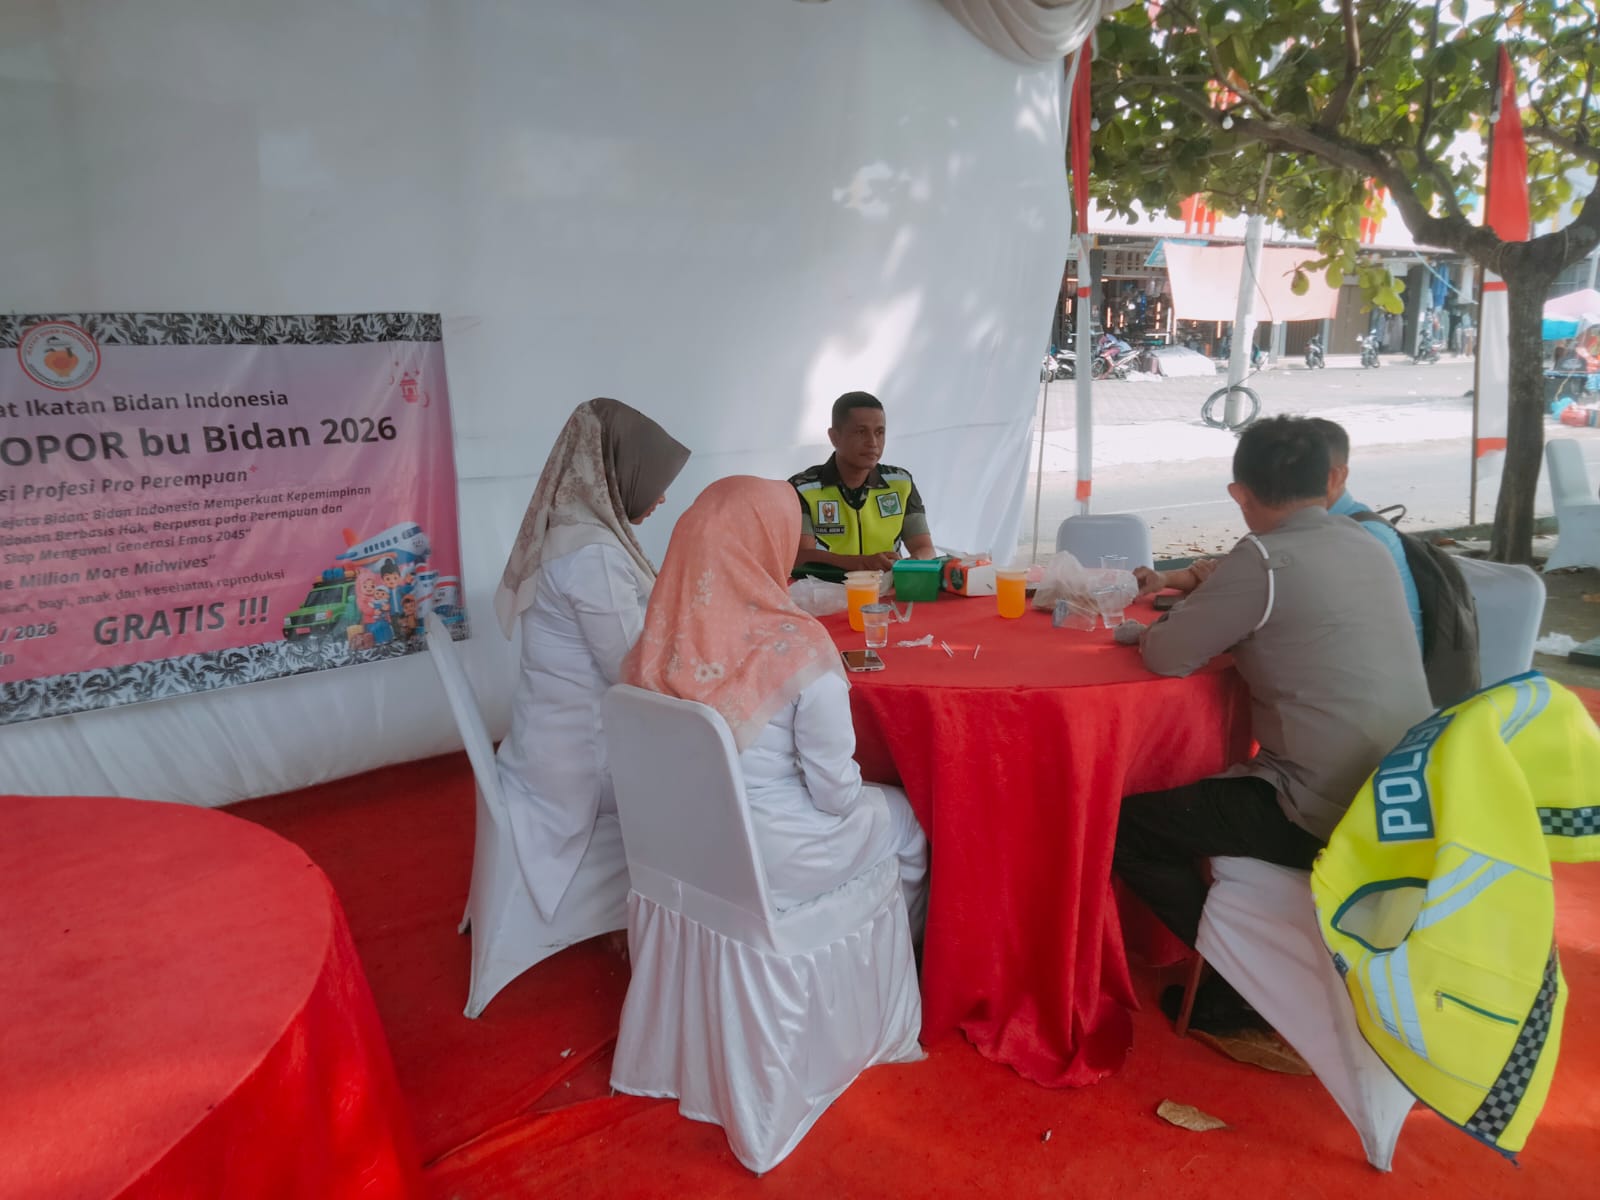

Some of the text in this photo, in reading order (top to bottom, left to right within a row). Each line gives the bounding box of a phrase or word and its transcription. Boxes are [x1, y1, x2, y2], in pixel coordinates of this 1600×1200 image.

[26, 399, 106, 416] Ikatan
[112, 393, 179, 412] Bidan
[185, 390, 289, 408] Indonesia
[0, 416, 397, 467] OPOR bu Bidan 2026
[23, 480, 95, 501] Profesi
[102, 478, 134, 493] Pro
[141, 470, 248, 490] Perempuan
[93, 507, 132, 520] Bidan
[136, 501, 201, 517] Indonesia
[204, 493, 286, 511] Memperkuat
[287, 486, 372, 503] Kepemimpinan
[55, 527, 115, 541] Berbasis
[118, 522, 149, 535] Hak,
[152, 516, 213, 531] Berpusat
[215, 512, 247, 528] pada
[250, 506, 319, 521] Perempuan
[321, 504, 344, 515] dan
[40, 543, 112, 561] Mengawal
[115, 536, 175, 553] Generasi
[178, 533, 214, 546] Emas
[20, 571, 81, 588] Million
[86, 566, 130, 581] More
[216, 569, 286, 588] reproduksi
[14, 621, 59, 640] 2026
[94, 595, 270, 646] GRATIS !!!
